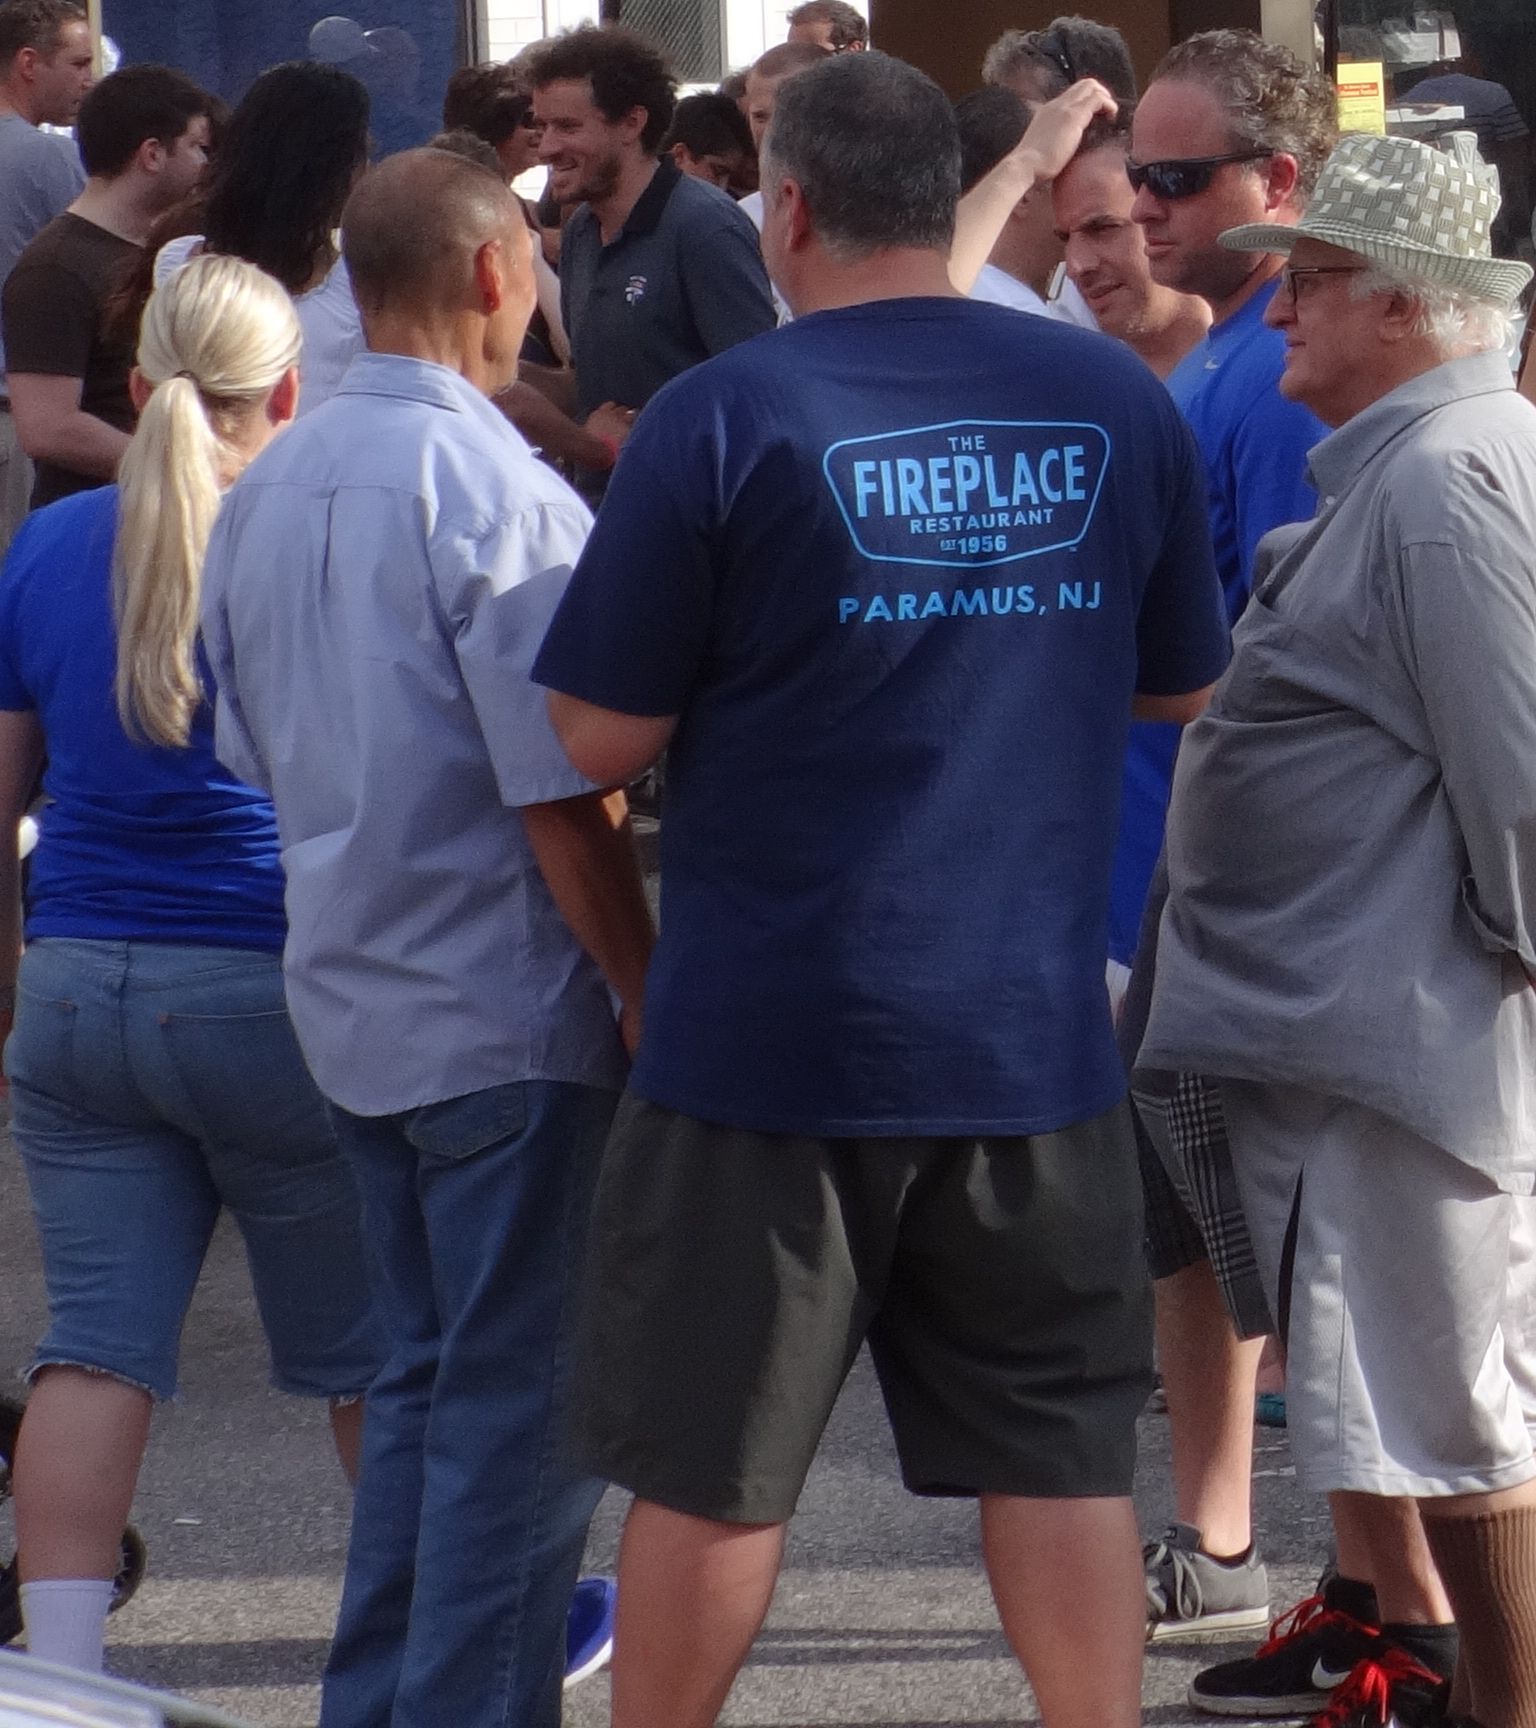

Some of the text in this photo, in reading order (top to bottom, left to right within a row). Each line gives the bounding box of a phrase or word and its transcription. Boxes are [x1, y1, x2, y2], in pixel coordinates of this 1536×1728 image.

[947, 434, 987, 452] THE
[853, 444, 1086, 518] FIREPLACE
[909, 508, 1054, 534] RESTAURANT
[957, 534, 1008, 555] 1956
[838, 581, 1101, 624] PARAMUS, NJ
